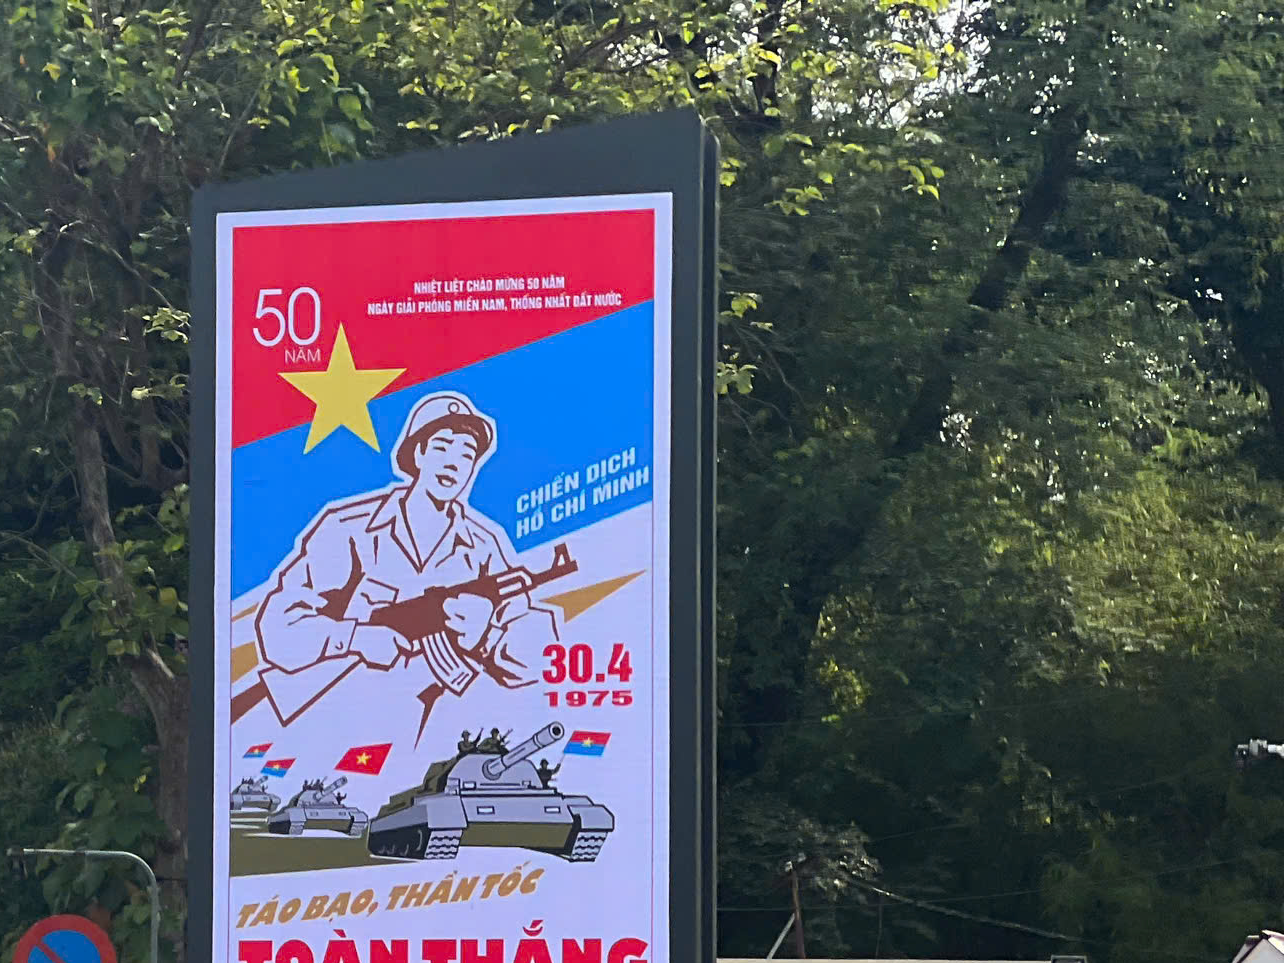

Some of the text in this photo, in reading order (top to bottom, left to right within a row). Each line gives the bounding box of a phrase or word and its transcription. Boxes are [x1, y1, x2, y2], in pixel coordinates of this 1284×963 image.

[367, 300, 394, 316] NGÀY
[396, 297, 416, 314] GIẢI
[418, 298, 451, 313] PHÓNG
[453, 296, 480, 312] MIỀN
[482, 298, 508, 312] NAM,
[510, 292, 542, 309] THỐNG
[544, 292, 571, 308] NHẤT
[573, 291, 592, 307] ĐẤT
[414, 279, 442, 296] NHIỆT
[444, 278, 464, 295] LIỆT
[466, 277, 493, 293] CHÀO
[527, 278, 540, 290] 50
[542, 274, 565, 289] NĂM
[253, 287, 321, 346] 50
[285, 347, 321, 363] NĂM
[516, 447, 636, 514] CHIẾN DỊCH
[516, 465, 649, 539] HỒ CHÍ MINH
[542, 643, 633, 684] 30.4
[543, 690, 633, 707] 1975
[236, 861, 545, 929] TÁO BẠO, THẦN TỐC
